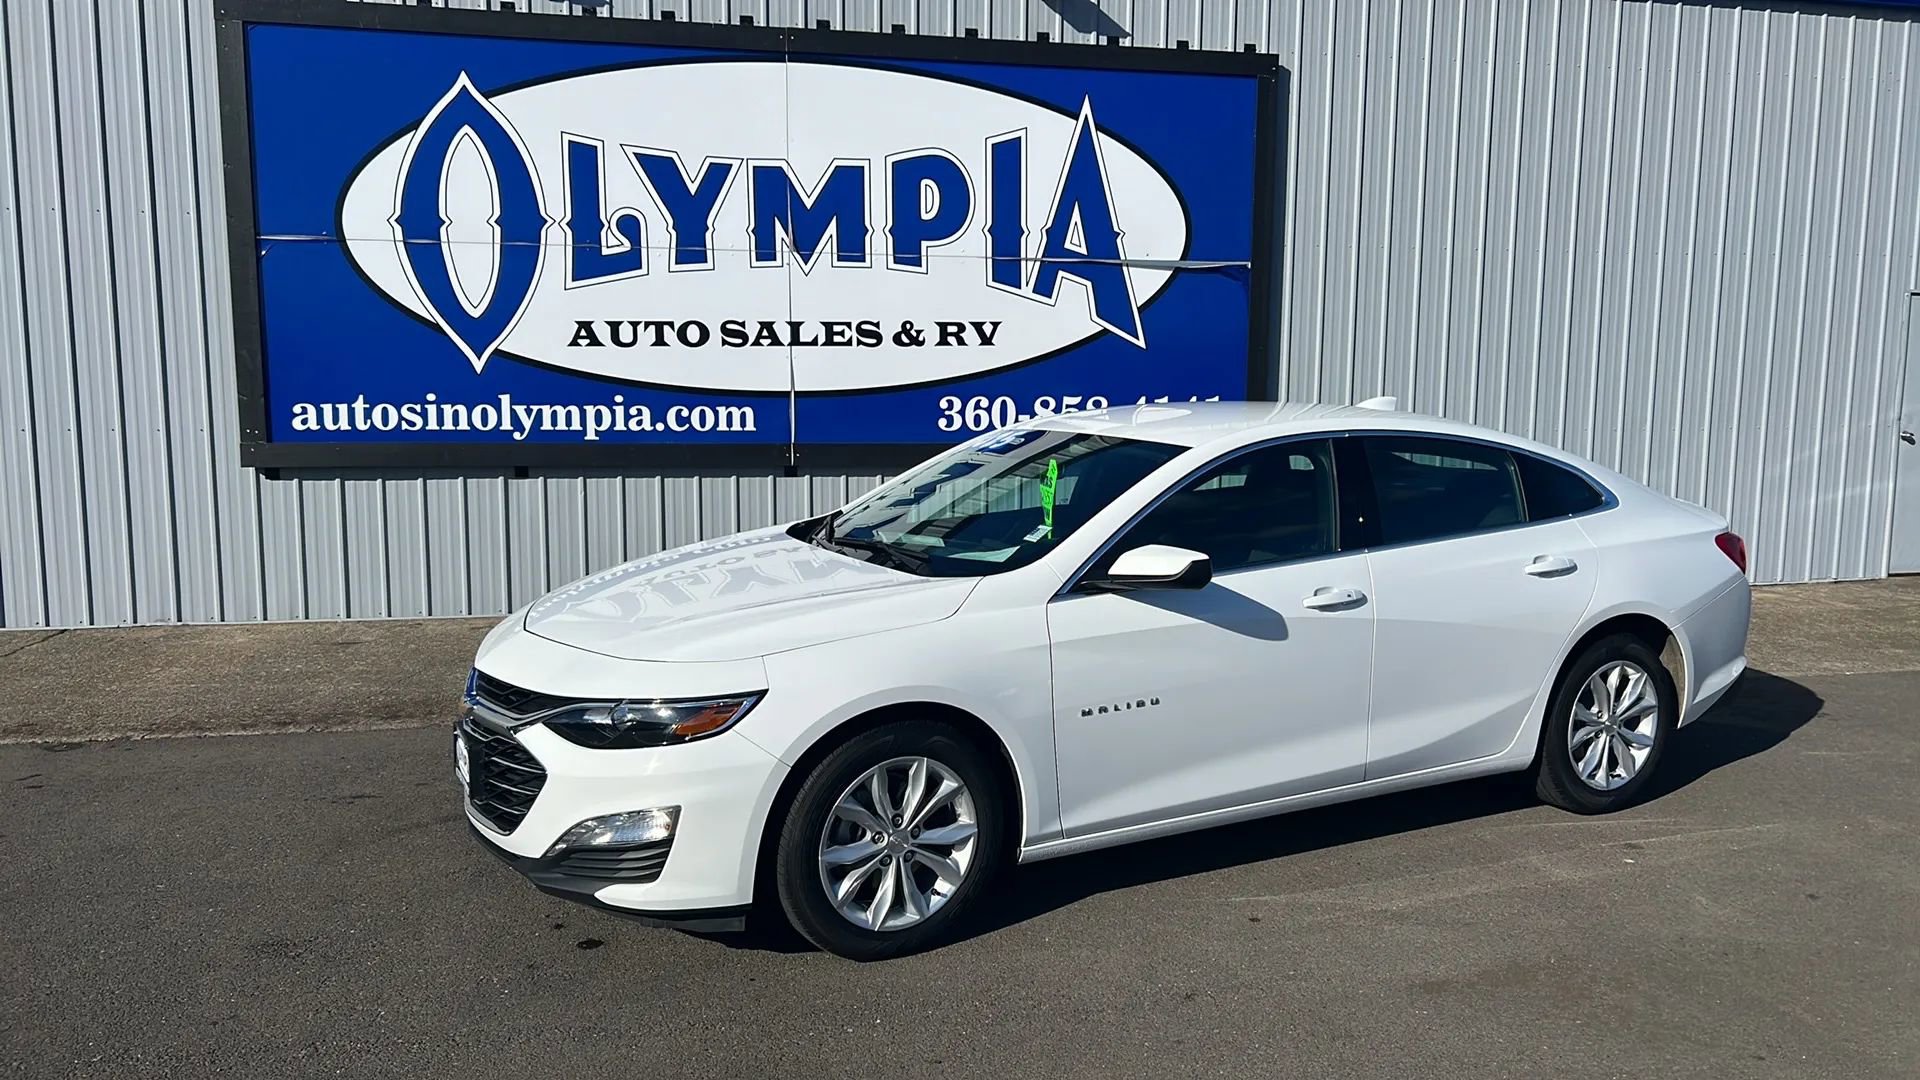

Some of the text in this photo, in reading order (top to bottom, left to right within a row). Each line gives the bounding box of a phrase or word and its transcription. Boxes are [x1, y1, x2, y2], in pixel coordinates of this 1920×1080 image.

[387, 70, 1147, 374] OLYMPIA
[567, 320, 1003, 348] AUTO SALES & RV
[291, 393, 757, 441] autosinolympia.com
[1081, 697, 1160, 717] MALIBU
